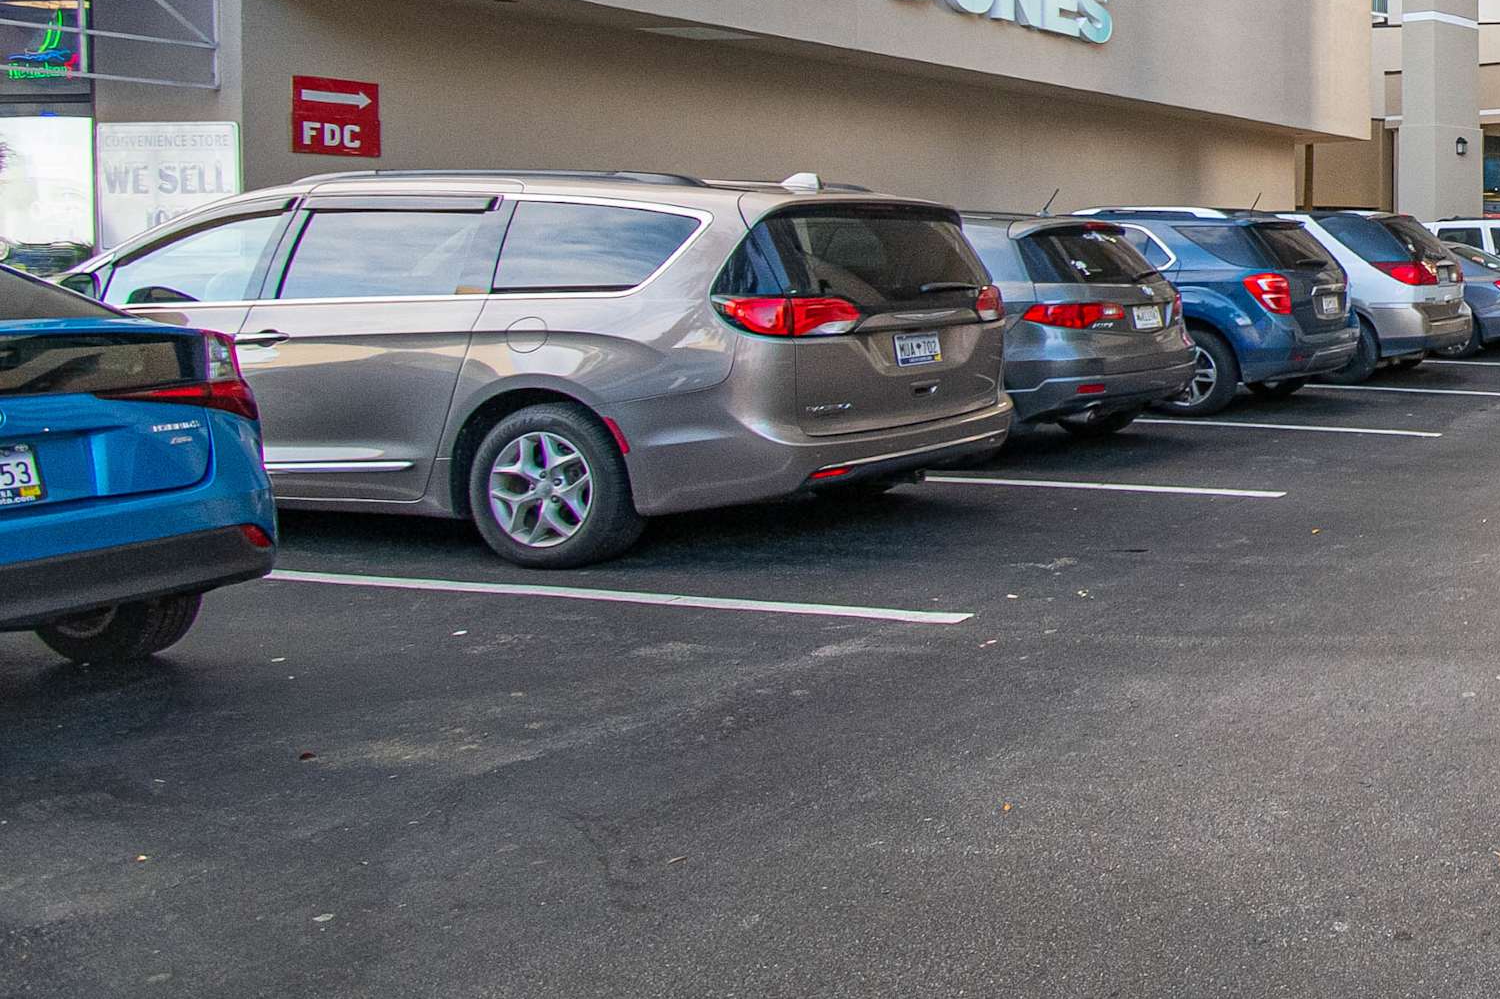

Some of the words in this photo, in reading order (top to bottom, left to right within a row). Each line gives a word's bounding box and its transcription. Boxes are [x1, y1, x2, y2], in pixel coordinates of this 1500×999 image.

[105, 135, 189, 147] CONVENIENCE
[191, 134, 229, 147] STORE
[302, 121, 361, 148] FDC
[104, 161, 149, 194] WE
[158, 161, 232, 194] SELL
[0, 461, 32, 486] 53
